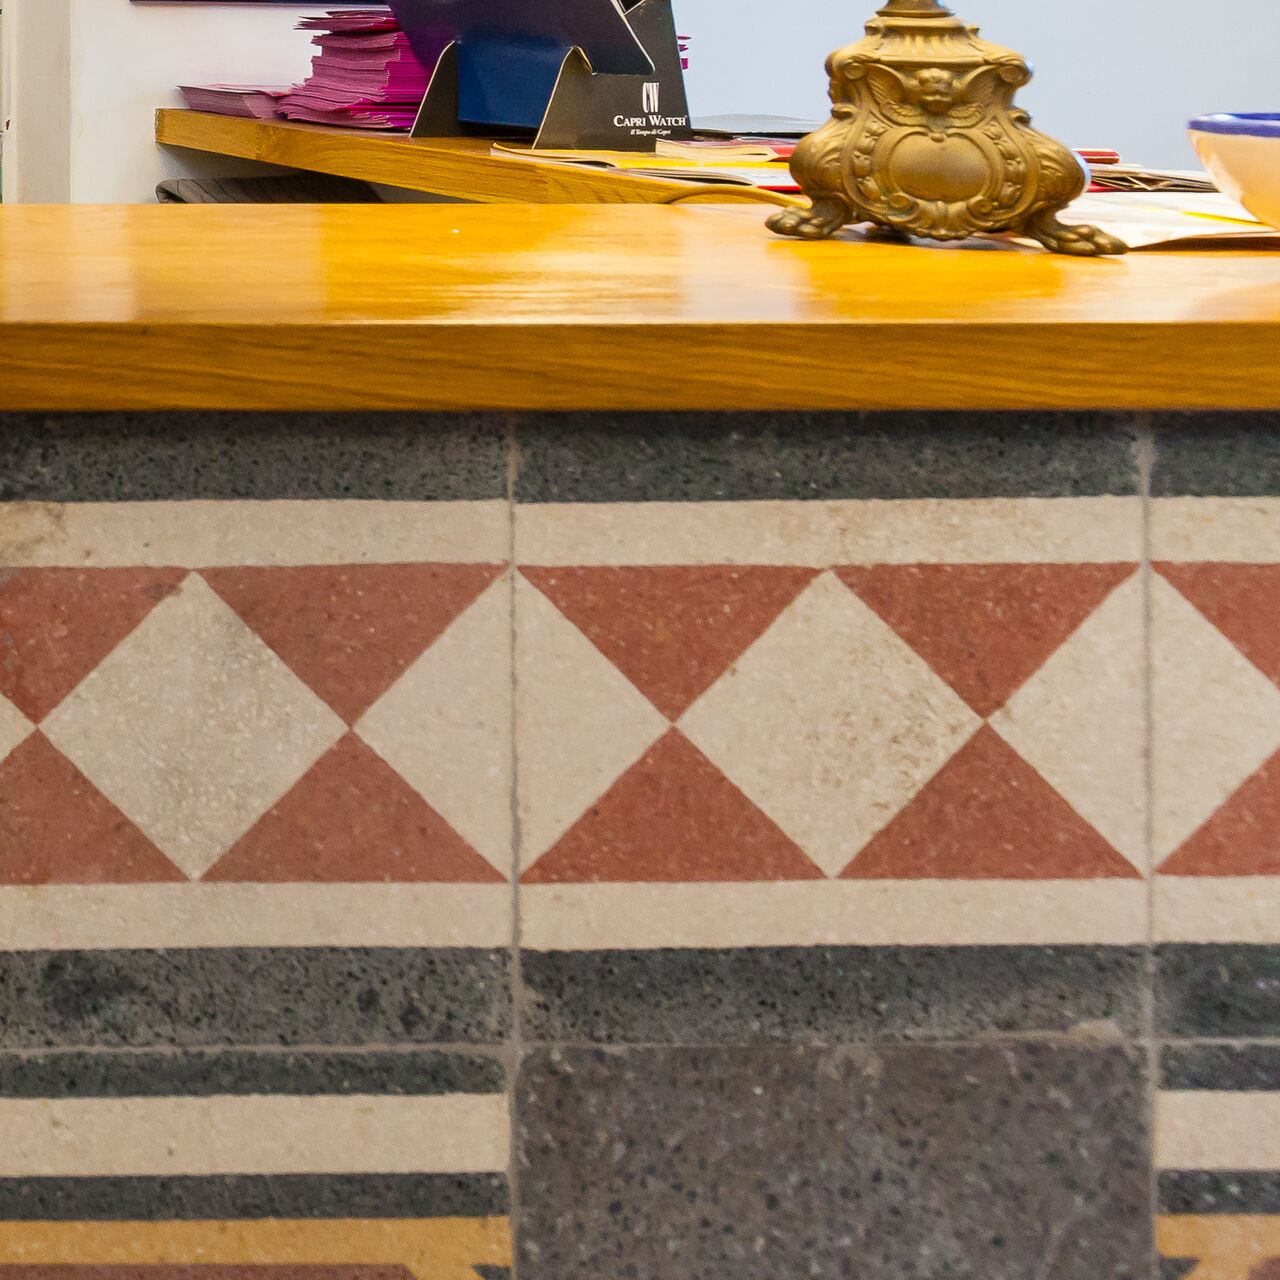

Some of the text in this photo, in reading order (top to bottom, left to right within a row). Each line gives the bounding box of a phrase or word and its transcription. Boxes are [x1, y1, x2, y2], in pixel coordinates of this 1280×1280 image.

[613, 114, 686, 127] CAPRI WATCH
[657, 129, 672, 137] Capri
